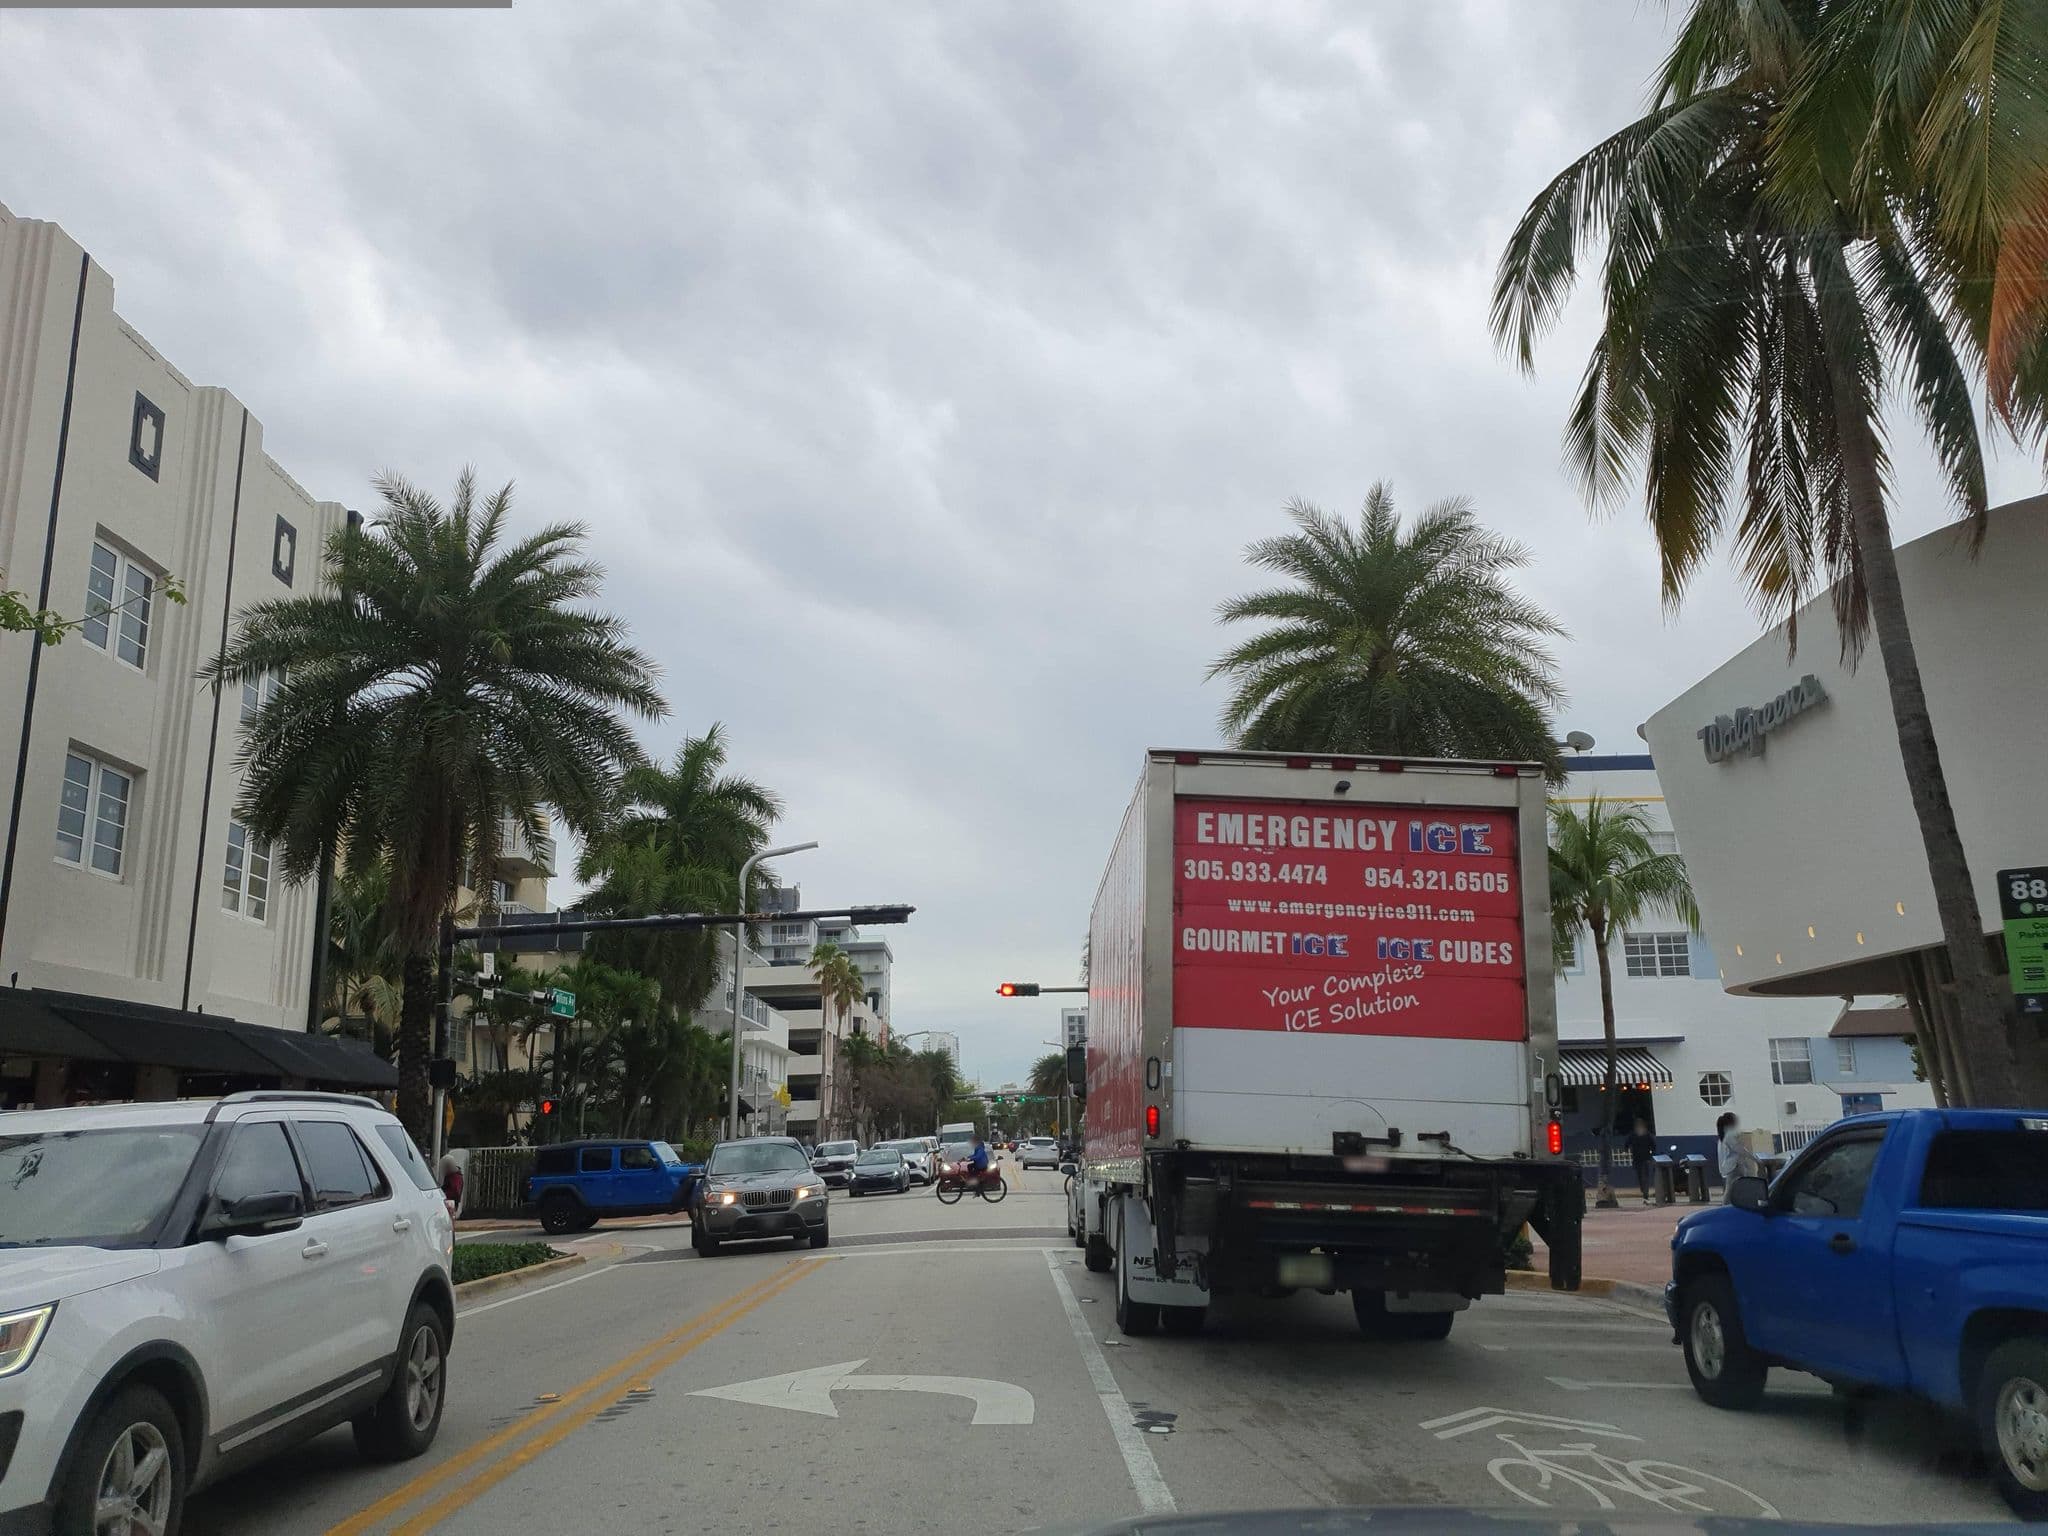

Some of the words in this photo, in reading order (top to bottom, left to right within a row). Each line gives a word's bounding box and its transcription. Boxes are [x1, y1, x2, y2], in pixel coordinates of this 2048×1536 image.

[1697, 675, 1828, 763] Walgreens
[1197, 812, 1398, 851] EMERGENCY
[1409, 820, 1492, 855] ICE
[1184, 859, 1328, 886] 305.933.4474
[1364, 867, 1510, 893] 954.321.6505
[1228, 898, 1476, 922] www.emergencyice911.com
[1182, 927, 1287, 955] GOURMET
[1291, 932, 1350, 957] ICE
[1377, 936, 1435, 962] ICE
[1439, 940, 1513, 965] CUBES
[1262, 984, 1316, 1009] Your
[1323, 962, 1425, 998] Complete
[1285, 1008, 1321, 1031] ICE
[1330, 991, 1420, 1024] Solution
